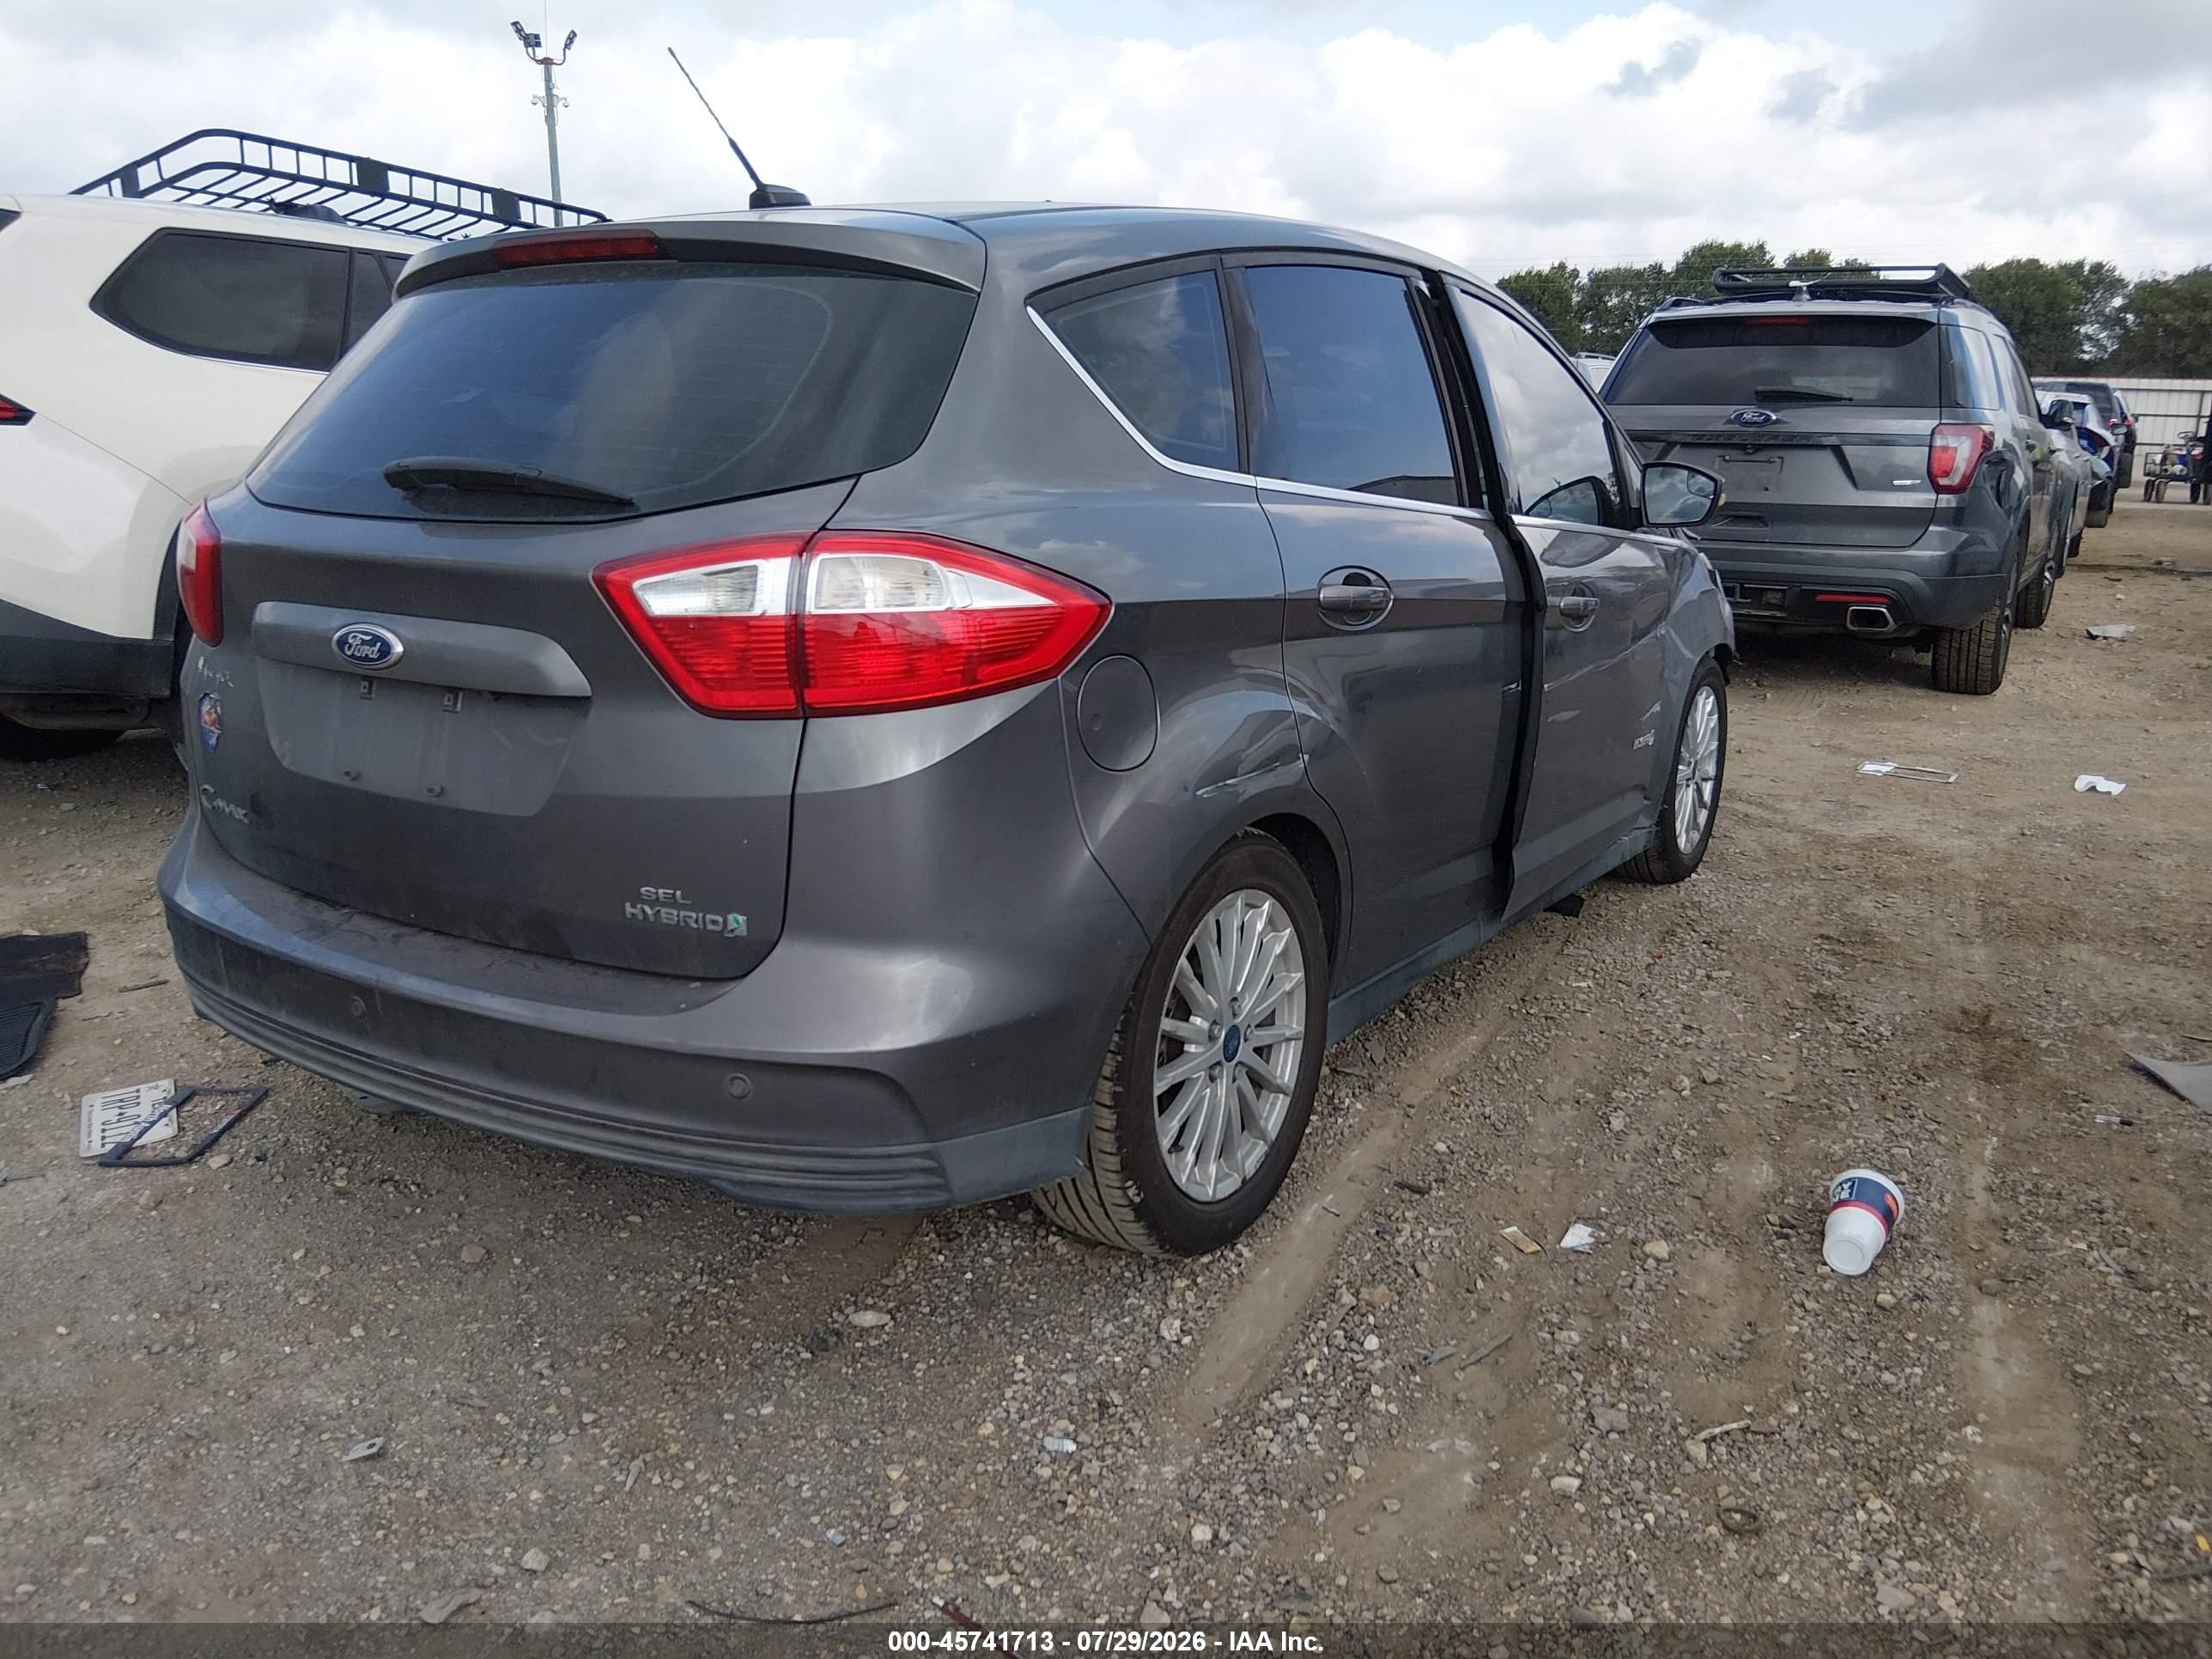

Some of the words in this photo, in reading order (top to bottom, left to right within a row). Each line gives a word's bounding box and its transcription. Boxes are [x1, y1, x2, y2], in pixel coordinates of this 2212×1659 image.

[1740, 411, 1766, 423] Ford
[344, 632, 382, 659] Ford
[640, 886, 693, 905] SEL
[624, 902, 723, 932] HYBRID
